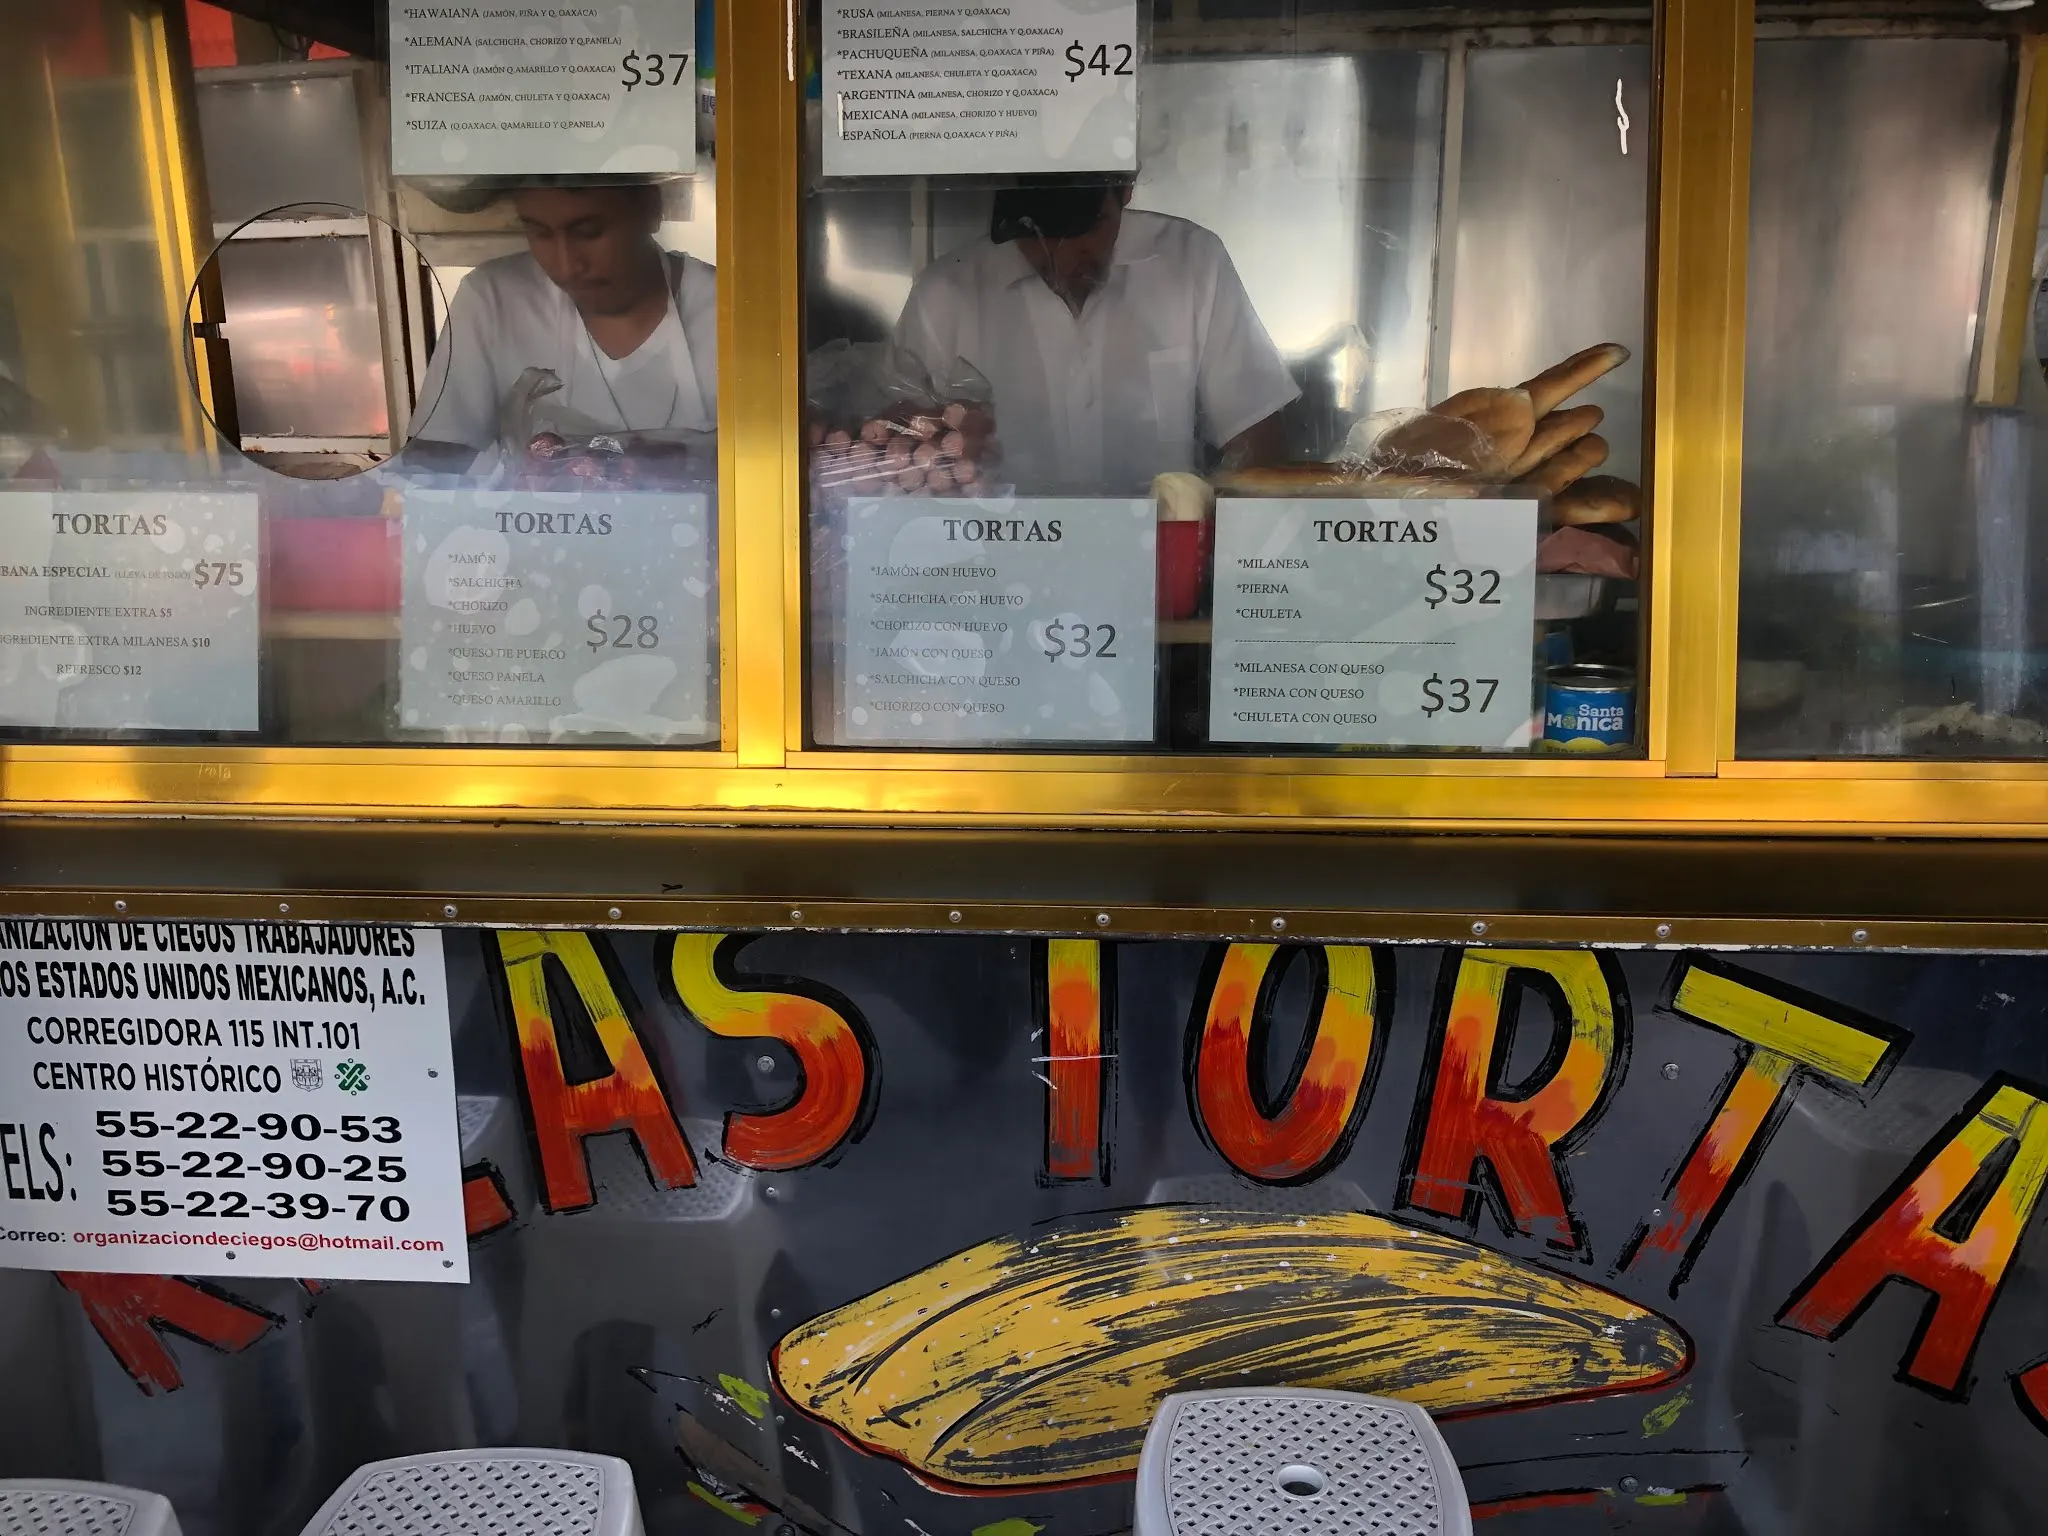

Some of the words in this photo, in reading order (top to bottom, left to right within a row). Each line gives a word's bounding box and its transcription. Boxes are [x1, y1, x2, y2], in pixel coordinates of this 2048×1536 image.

[519, 9, 539, 17] PIÑA
[559, 9, 598, 18] OAXACA)
[925, 9, 955, 17] PIERNA
[961, 28, 1008, 36] SALCHICHA
[529, 38, 568, 46] CHORIZO
[1032, 47, 1055, 56] PIÑA)
[1065, 40, 1134, 83] $42
[621, 49, 690, 92] $37
[943, 70, 982, 78] CHULETA
[966, 90, 1004, 98] CHORIZO
[959, 110, 997, 118] CHORIZO
[1006, 109, 1038, 118] HUEVO)
[995, 129, 1018, 138] PIÑA)
[53, 513, 168, 536] TORTAS
[495, 511, 613, 535] TORTAS
[943, 519, 1062, 542] TORTAS
[1313, 520, 1438, 543] TORTAS
[42, 566, 110, 578] ESPECIAL
[194, 559, 244, 590] $75
[922, 567, 950, 577] CON
[952, 567, 996, 578] HUEVO
[1424, 564, 1501, 609] $32
[950, 595, 976, 605] CON
[979, 595, 1024, 606] HUEVO
[25, 606, 111, 617] INGREDIENTE
[115, 607, 157, 618] EXTRA
[160, 607, 172, 618] $5
[586, 609, 660, 653] $28
[934, 621, 961, 631] CON
[964, 622, 1008, 633] HUEVO
[78, 636, 119, 646] EXTRA
[123, 636, 189, 647] MILANESA
[192, 637, 210, 648] $10
[1044, 618, 1118, 663] $32
[516, 649, 566, 660] PUERCO
[921, 648, 949, 659] CON
[951, 649, 994, 661] QUESO
[56, 664, 120, 675] REFRESCO
[123, 665, 142, 676] $12
[1309, 664, 1338, 674] CON
[1340, 664, 1385, 676] QUESO
[497, 672, 545, 683] PANELA
[948, 675, 975, 686] CON
[978, 676, 1021, 689] QUESO
[1289, 688, 1318, 698] CON
[1320, 688, 1365, 700] QUESO
[1420, 672, 1500, 719] $37
[496, 695, 562, 707] AMARILLO
[933, 702, 960, 712] CON
[962, 703, 1005, 714] QUESO
[1578, 703, 1624, 717] Santa
[1302, 712, 1331, 723] CON
[1333, 713, 1377, 725] QUESO
[120, 922, 148, 952] DE
[153, 922, 235, 953] CIEGOS
[245, 925, 415, 958] TRABAJADORES
[0, 960, 31, 998] OS
[35, 961, 138, 1000] ESTADOS
[143, 962, 231, 1001] UNIDOS
[235, 964, 375, 1012] MEXICANOS,
[381, 967, 425, 1006] A.C.
[27, 1016, 222, 1047] CORREGIDORA
[228, 1019, 263, 1048] 115
[273, 1020, 361, 1050] INT.101
[33, 1061, 136, 1091] CENTRO
[144, 1056, 281, 1094] HISTÓRICO
[95, 1110, 403, 1143] 55-22-90-53
[101, 1150, 407, 1183] 55-22-90-25
[106, 1190, 410, 1222] 55-22-39-70
[73, 1230, 444, 1252] organizaciondeciegos@hotmail.com
